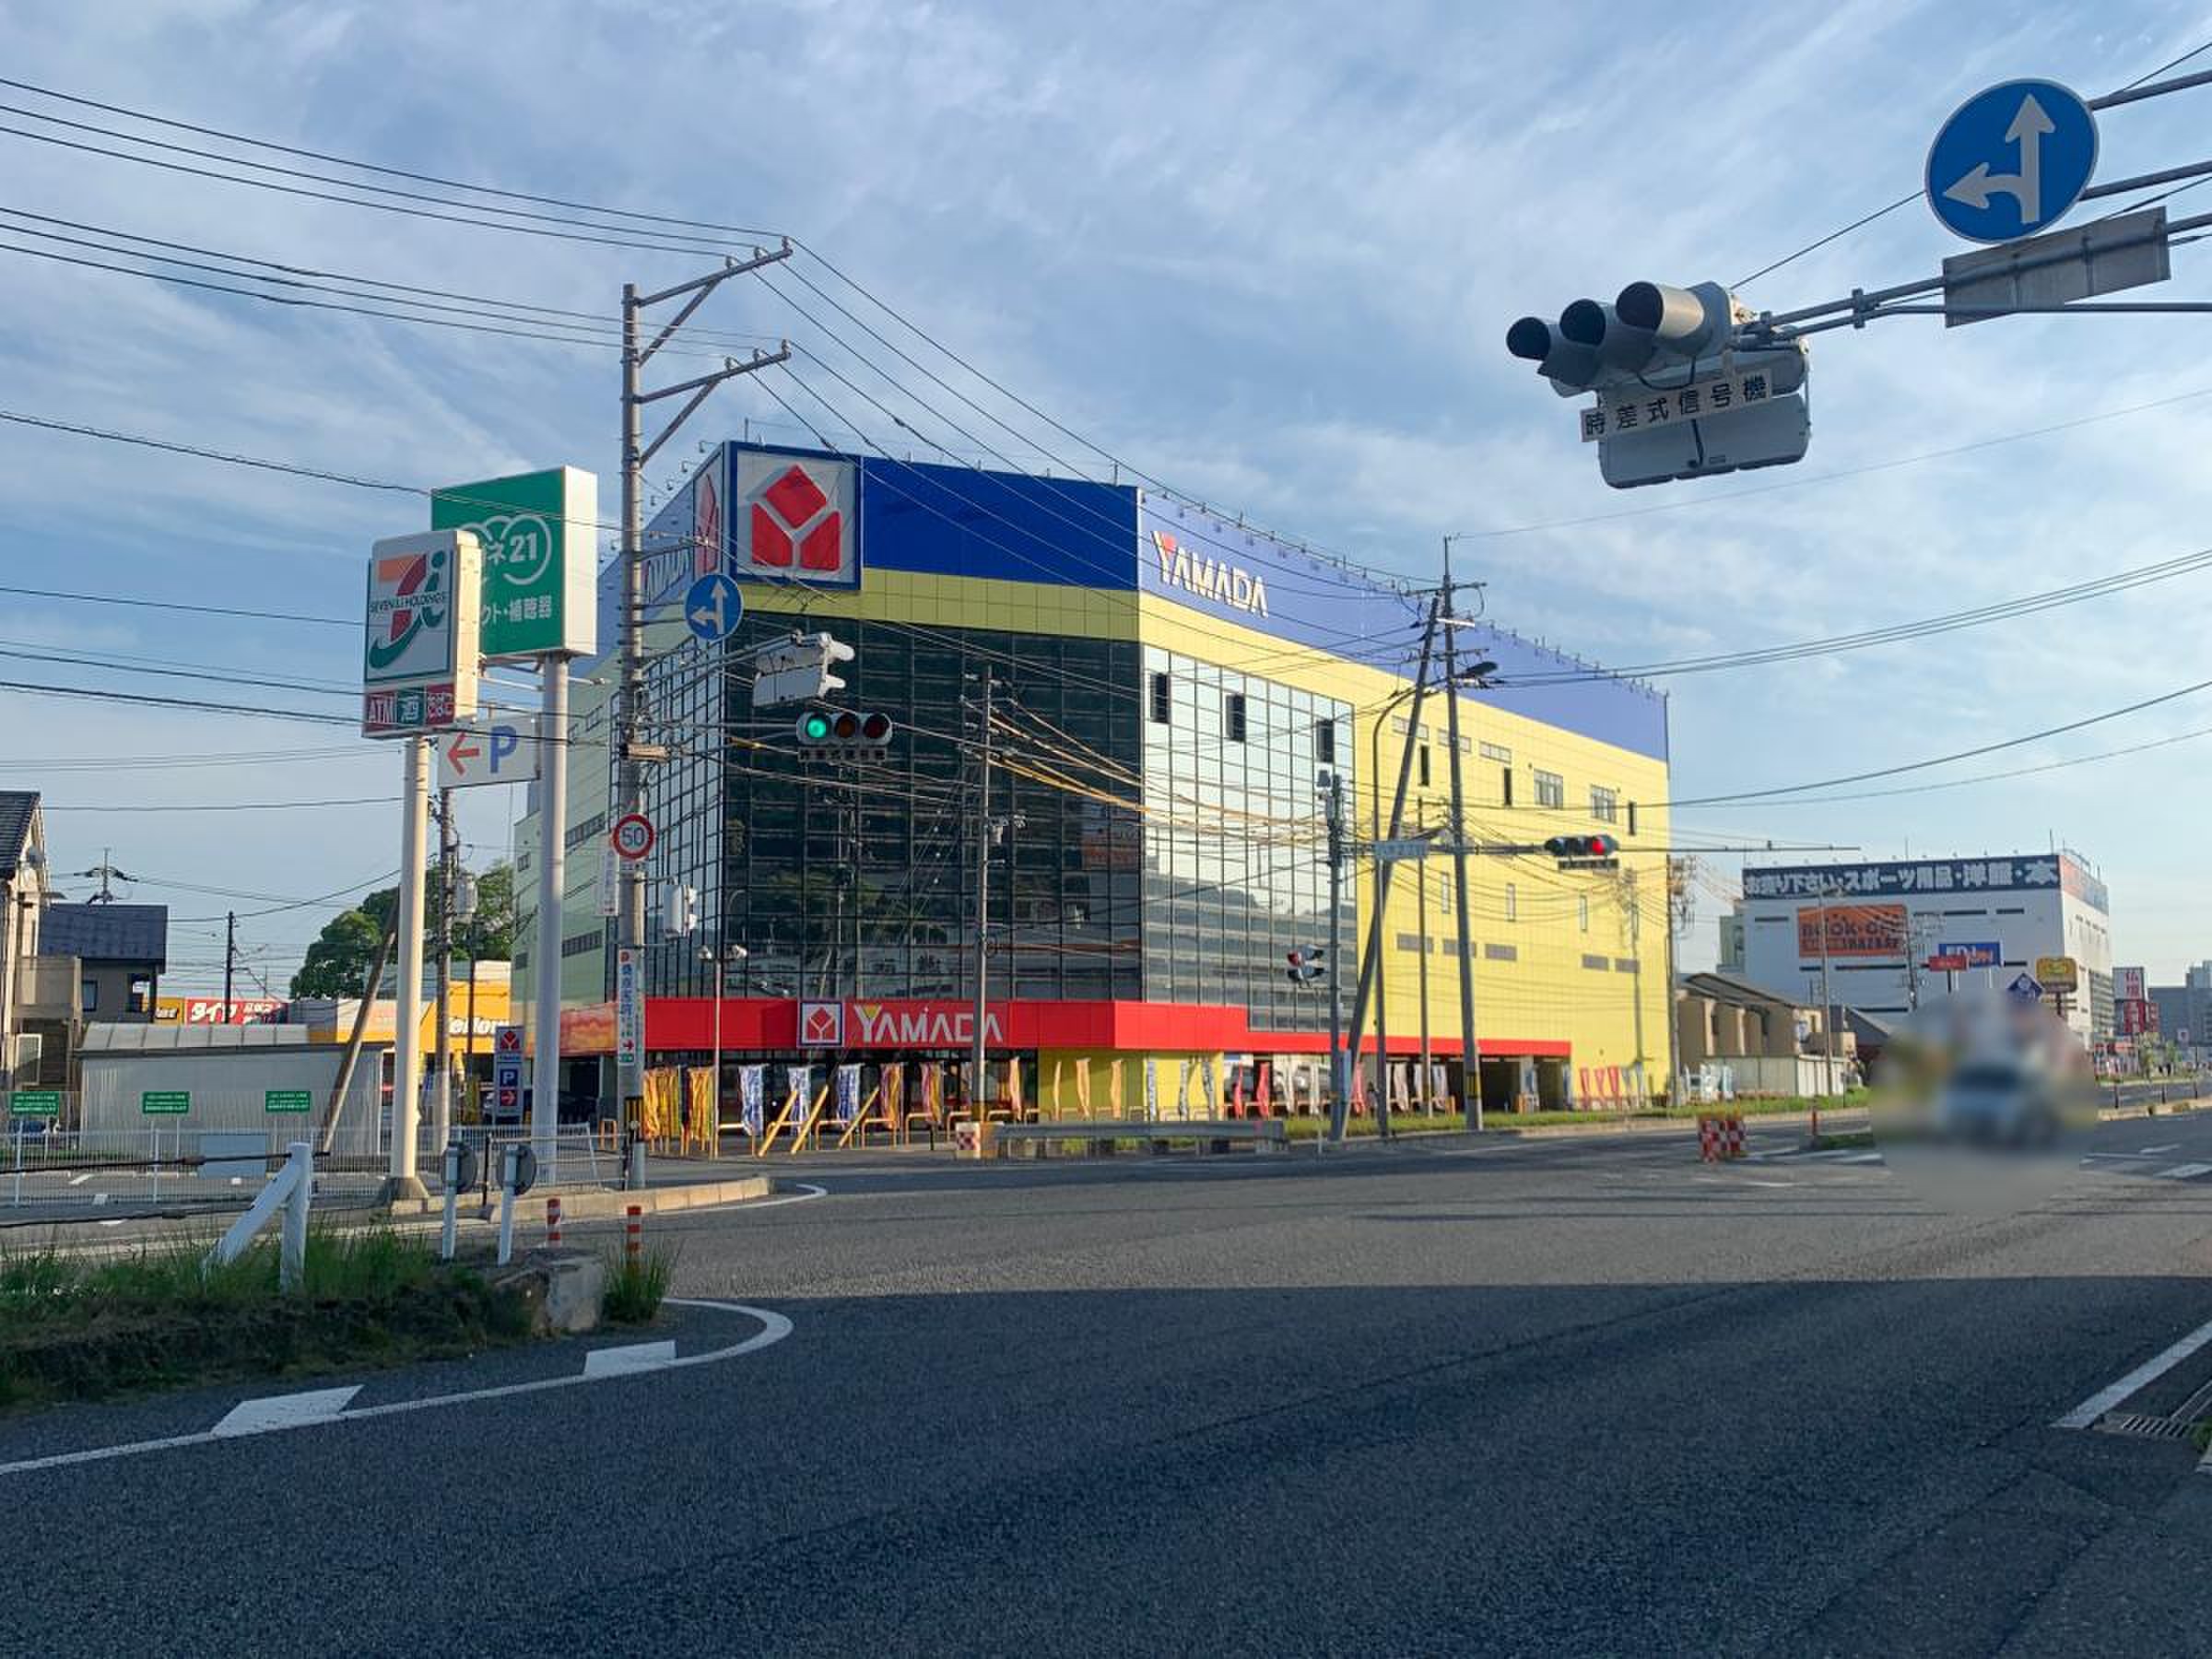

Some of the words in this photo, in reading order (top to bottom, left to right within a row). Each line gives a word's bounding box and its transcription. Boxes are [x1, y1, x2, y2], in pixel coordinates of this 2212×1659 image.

[1584, 376, 1767, 437] 時差式信号機
[1151, 531, 1269, 618] YAMADA
[490, 726, 517, 773] P
[622, 827, 645, 847] 50
[854, 1003, 1003, 1042] YAMADA
[503, 1071, 515, 1085] P
